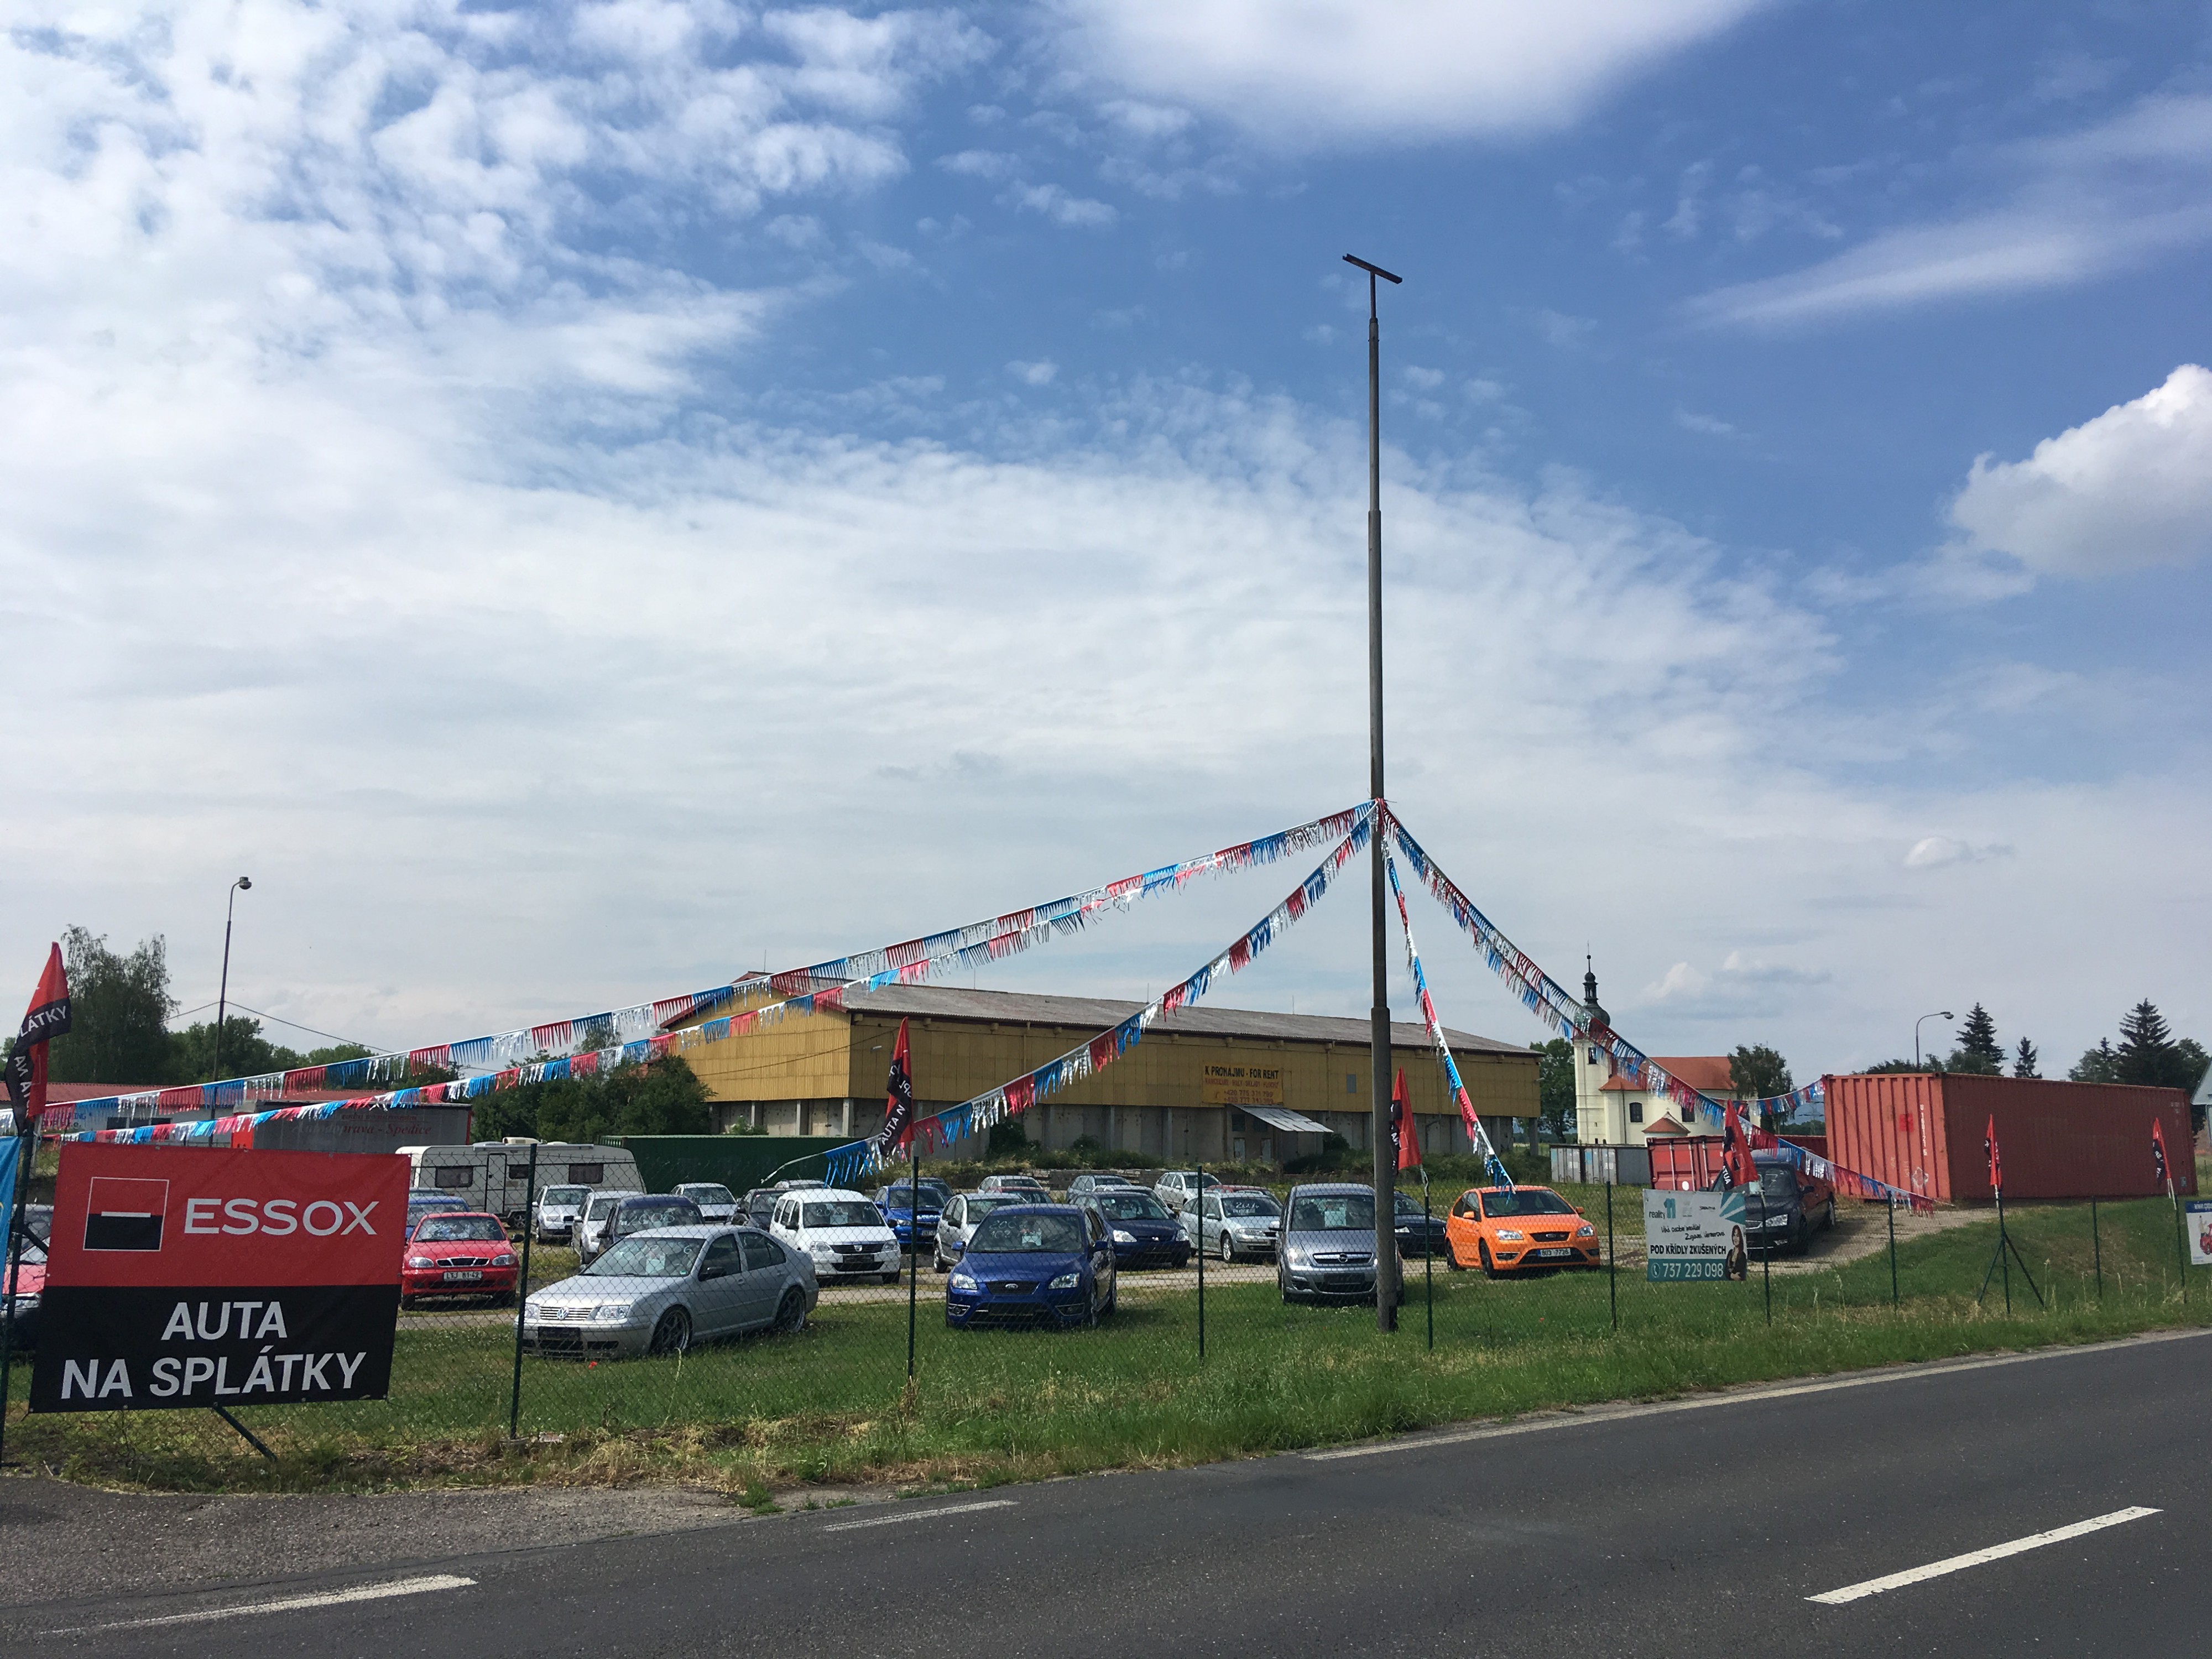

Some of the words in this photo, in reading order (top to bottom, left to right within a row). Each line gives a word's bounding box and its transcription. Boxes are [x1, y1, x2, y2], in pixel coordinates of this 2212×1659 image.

[15, 1005, 67, 1044] LÁTKY
[1205, 1066, 1209, 1075] K
[1250, 1068, 1261, 1078] FOR
[1263, 1070, 1279, 1079] RENT
[387, 1123, 431, 1136] Spedice
[184, 1198, 379, 1236] ESSOX
[1649, 1211, 1666, 1219] reality
[1650, 1245, 1664, 1254] POD
[1666, 1243, 1688, 1254] KŘÍDLY
[1689, 1243, 1726, 1255] ZKUŠENÝCH
[1663, 1263, 1681, 1277] 737
[1684, 1263, 1702, 1277] 229
[1705, 1263, 1724, 1277] 098
[160, 1301, 288, 1340] AUTA
[61, 1358, 133, 1399] NA
[149, 1345, 367, 1397] SPLÁTKY
